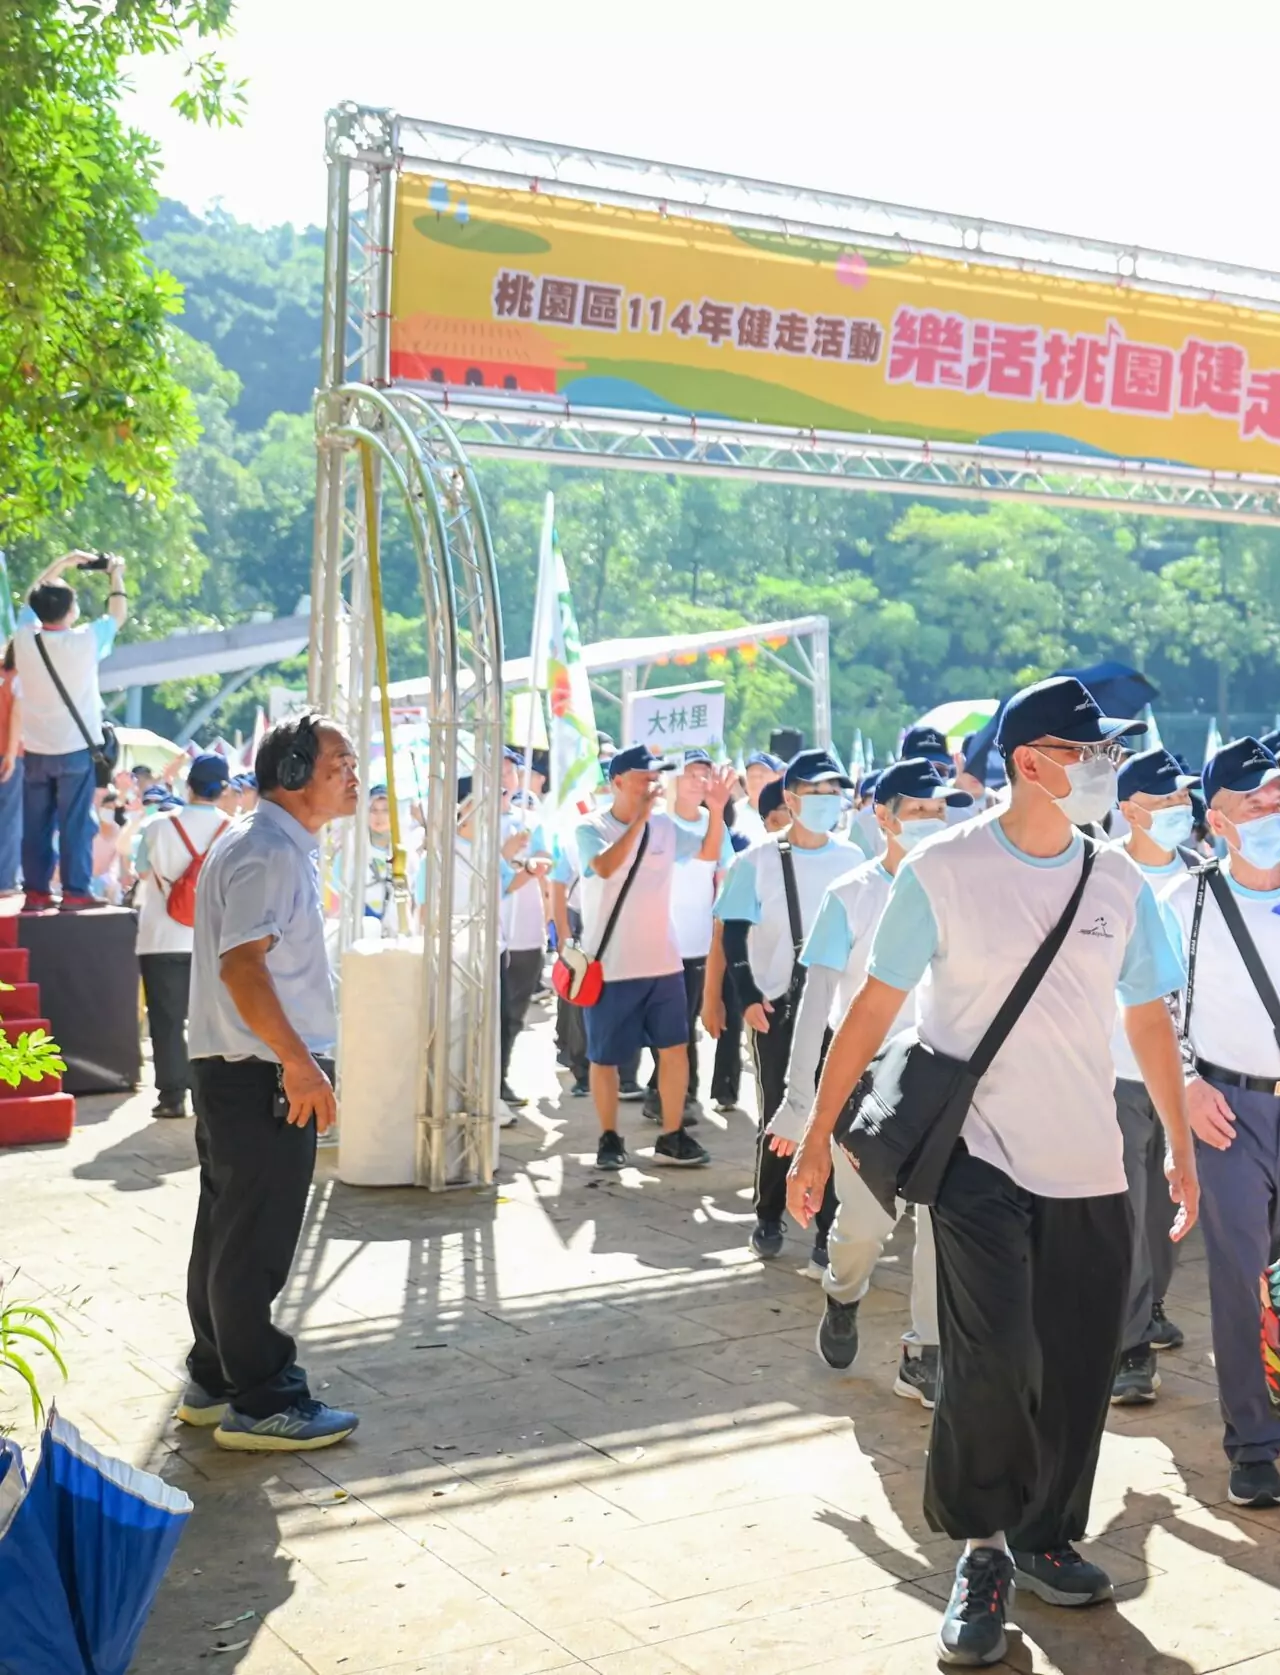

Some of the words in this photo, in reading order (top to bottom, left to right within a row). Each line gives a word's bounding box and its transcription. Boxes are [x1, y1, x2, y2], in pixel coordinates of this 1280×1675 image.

[494, 270, 884, 363] 桃園區114年健走活動
[647, 703, 709, 736] 大林里
